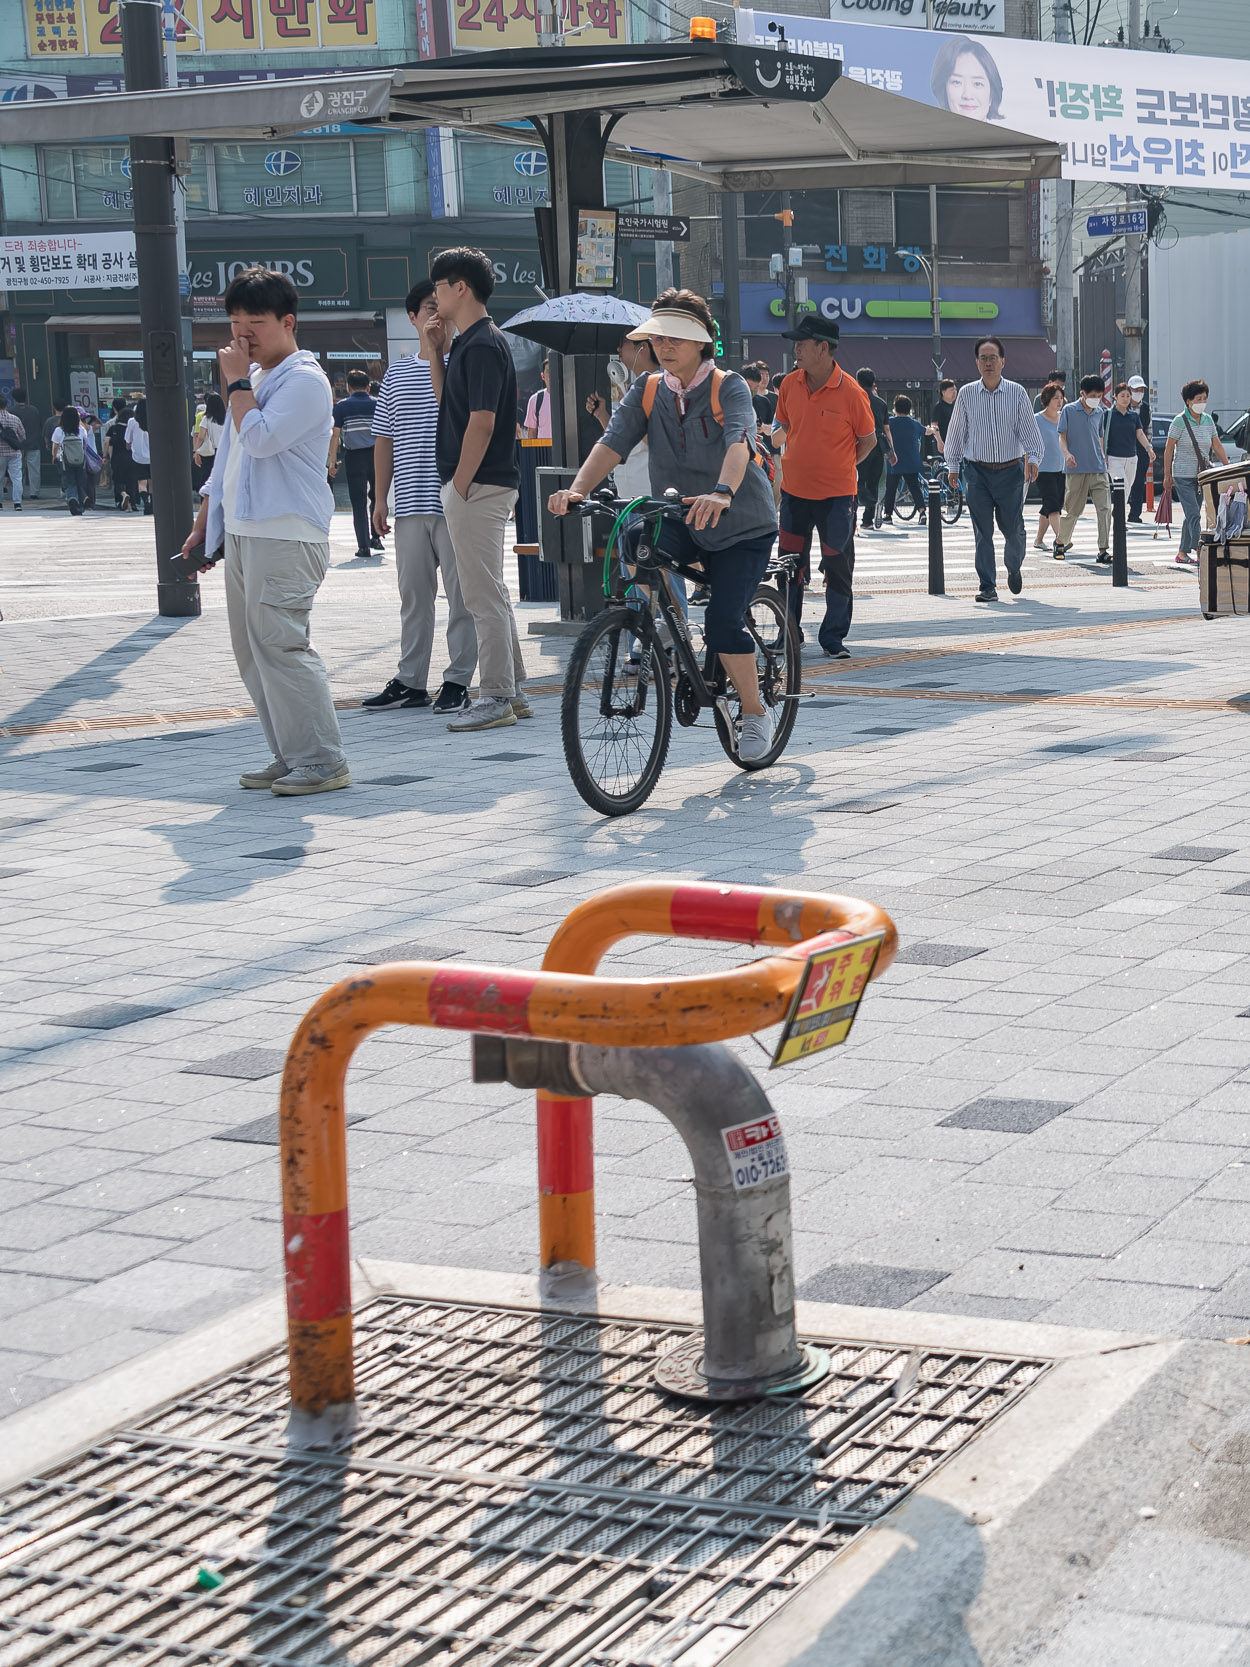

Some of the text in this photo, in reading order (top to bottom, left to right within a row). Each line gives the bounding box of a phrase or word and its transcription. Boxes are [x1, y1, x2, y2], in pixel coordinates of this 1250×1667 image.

[327, 90, 367, 108] 광진구
[243, 184, 323, 207] 혜민치과
[1101, 212, 1145, 227] 자양로16길
[4, 240, 24, 252] 드려
[14, 256, 26, 273] 및
[29, 254, 73, 273] 횡단보도
[76, 253, 98, 272] 확대
[101, 251, 124, 269] 공사
[5, 277, 29, 286] 광진구청
[30, 276, 70, 286] 02-450-7925
[83, 275, 101, 283] 시공사
[513, 261, 536, 284] les
[820, 296, 862, 320] CU
[905, 381, 920, 389] CU
